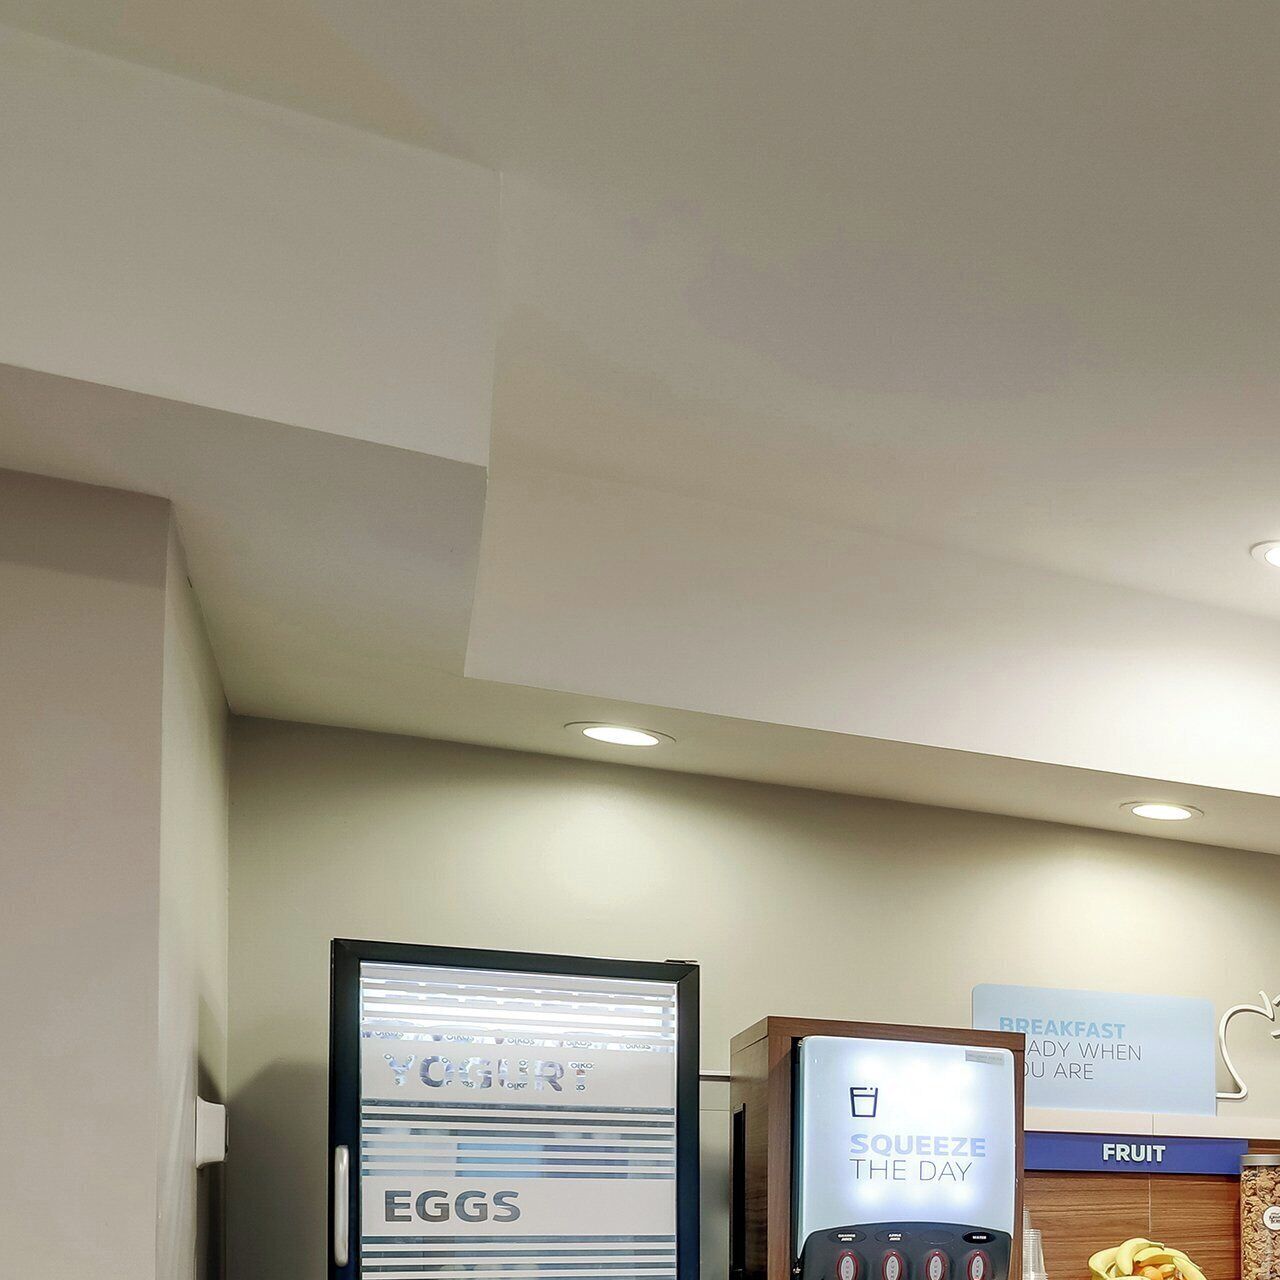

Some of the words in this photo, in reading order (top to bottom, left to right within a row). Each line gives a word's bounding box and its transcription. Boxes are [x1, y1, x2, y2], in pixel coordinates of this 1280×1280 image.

[1000, 1016, 1126, 1040] BREAKFAST
[1026, 1040, 1071, 1058] ADY
[1078, 1042, 1142, 1062] WHEN
[1053, 1062, 1094, 1080] ARE
[849, 1134, 987, 1158] SQUEEZE
[1102, 1143, 1167, 1164] FRUIT
[849, 1158, 907, 1182] THE
[919, 1160, 974, 1183] DAY
[384, 1190, 522, 1223] EGGS
